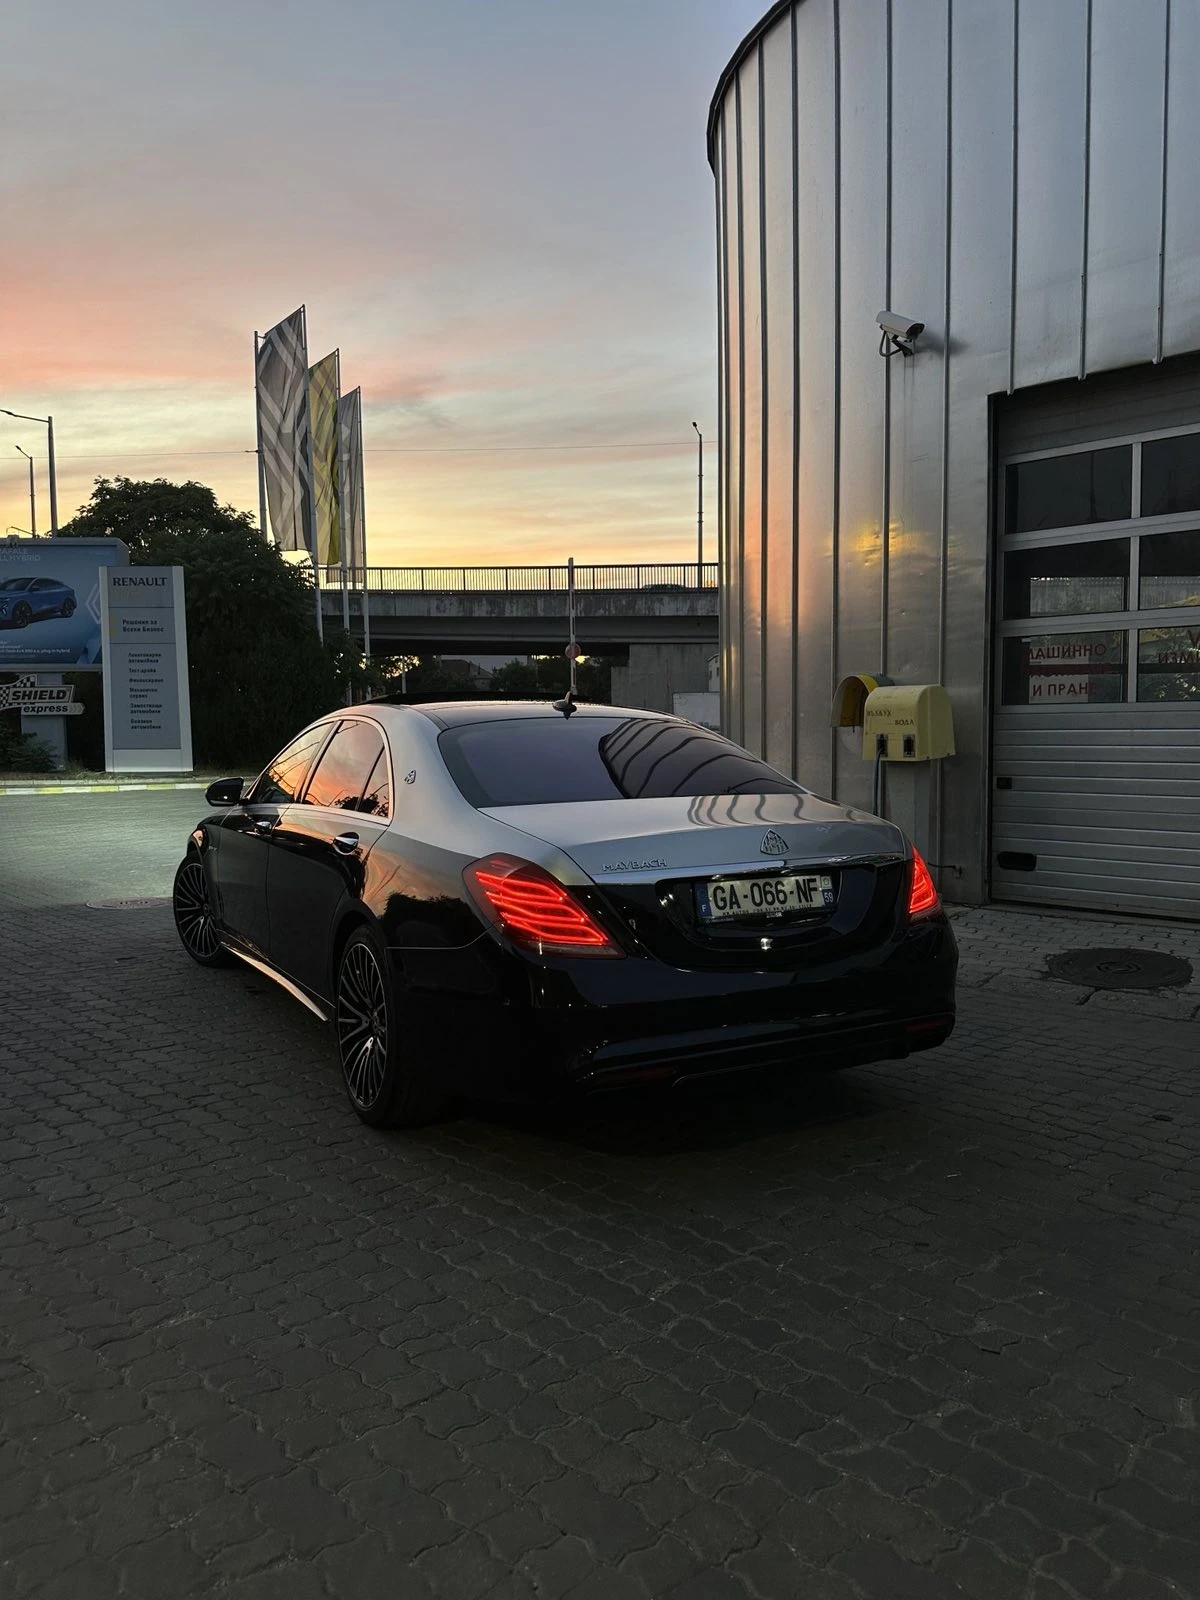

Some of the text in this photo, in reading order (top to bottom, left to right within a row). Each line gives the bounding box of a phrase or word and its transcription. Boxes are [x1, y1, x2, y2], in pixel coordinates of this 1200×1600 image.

[112, 577, 168, 587] RENAULT
[11, 689, 67, 701] SHIELD
[1033, 684, 1042, 697] И
[23, 705, 68, 714] express
[602, 859, 668, 872] MAYBACH
[712, 878, 819, 910] GA-066-NF
[823, 891, 834, 903] 59
[701, 904, 707, 913] F
